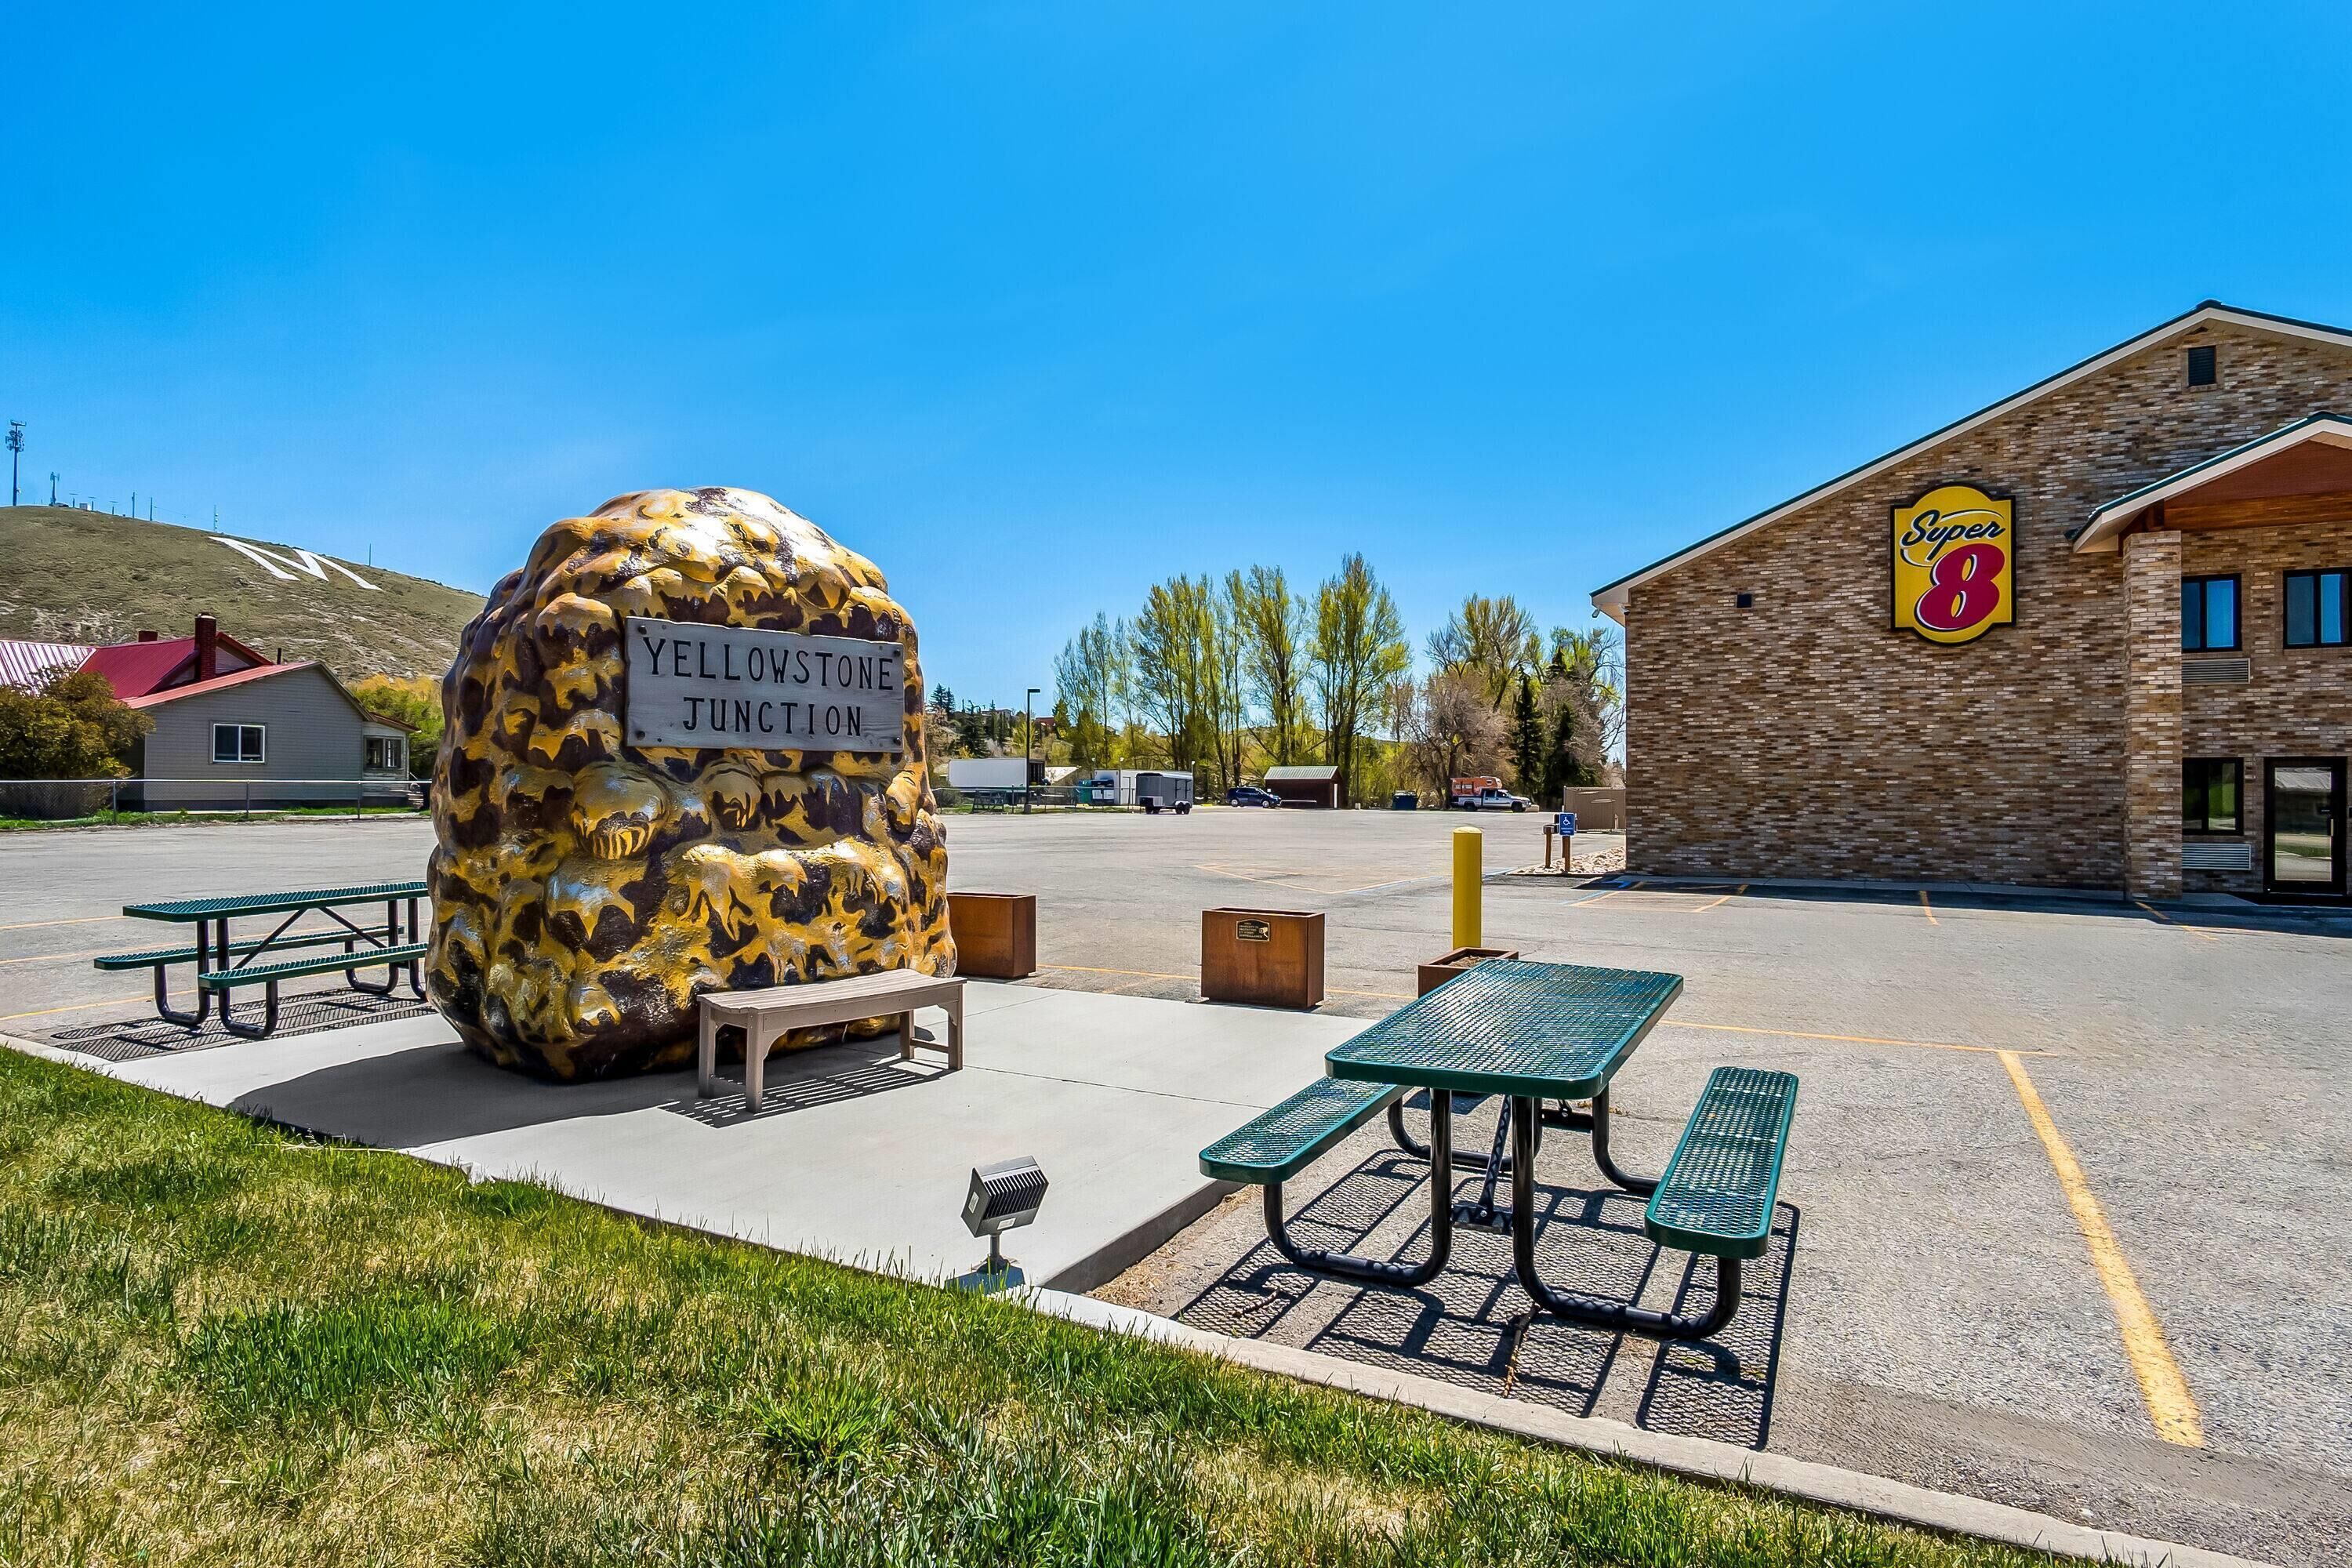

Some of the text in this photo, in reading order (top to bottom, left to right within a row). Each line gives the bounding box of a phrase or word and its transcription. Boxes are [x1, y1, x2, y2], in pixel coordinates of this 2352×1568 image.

[209, 535, 383, 591] M
[1900, 509, 2006, 562] Super
[1913, 543, 2005, 632] 8
[642, 636, 894, 691] YELLOWSTONE
[682, 696, 862, 737] JUNCTION
